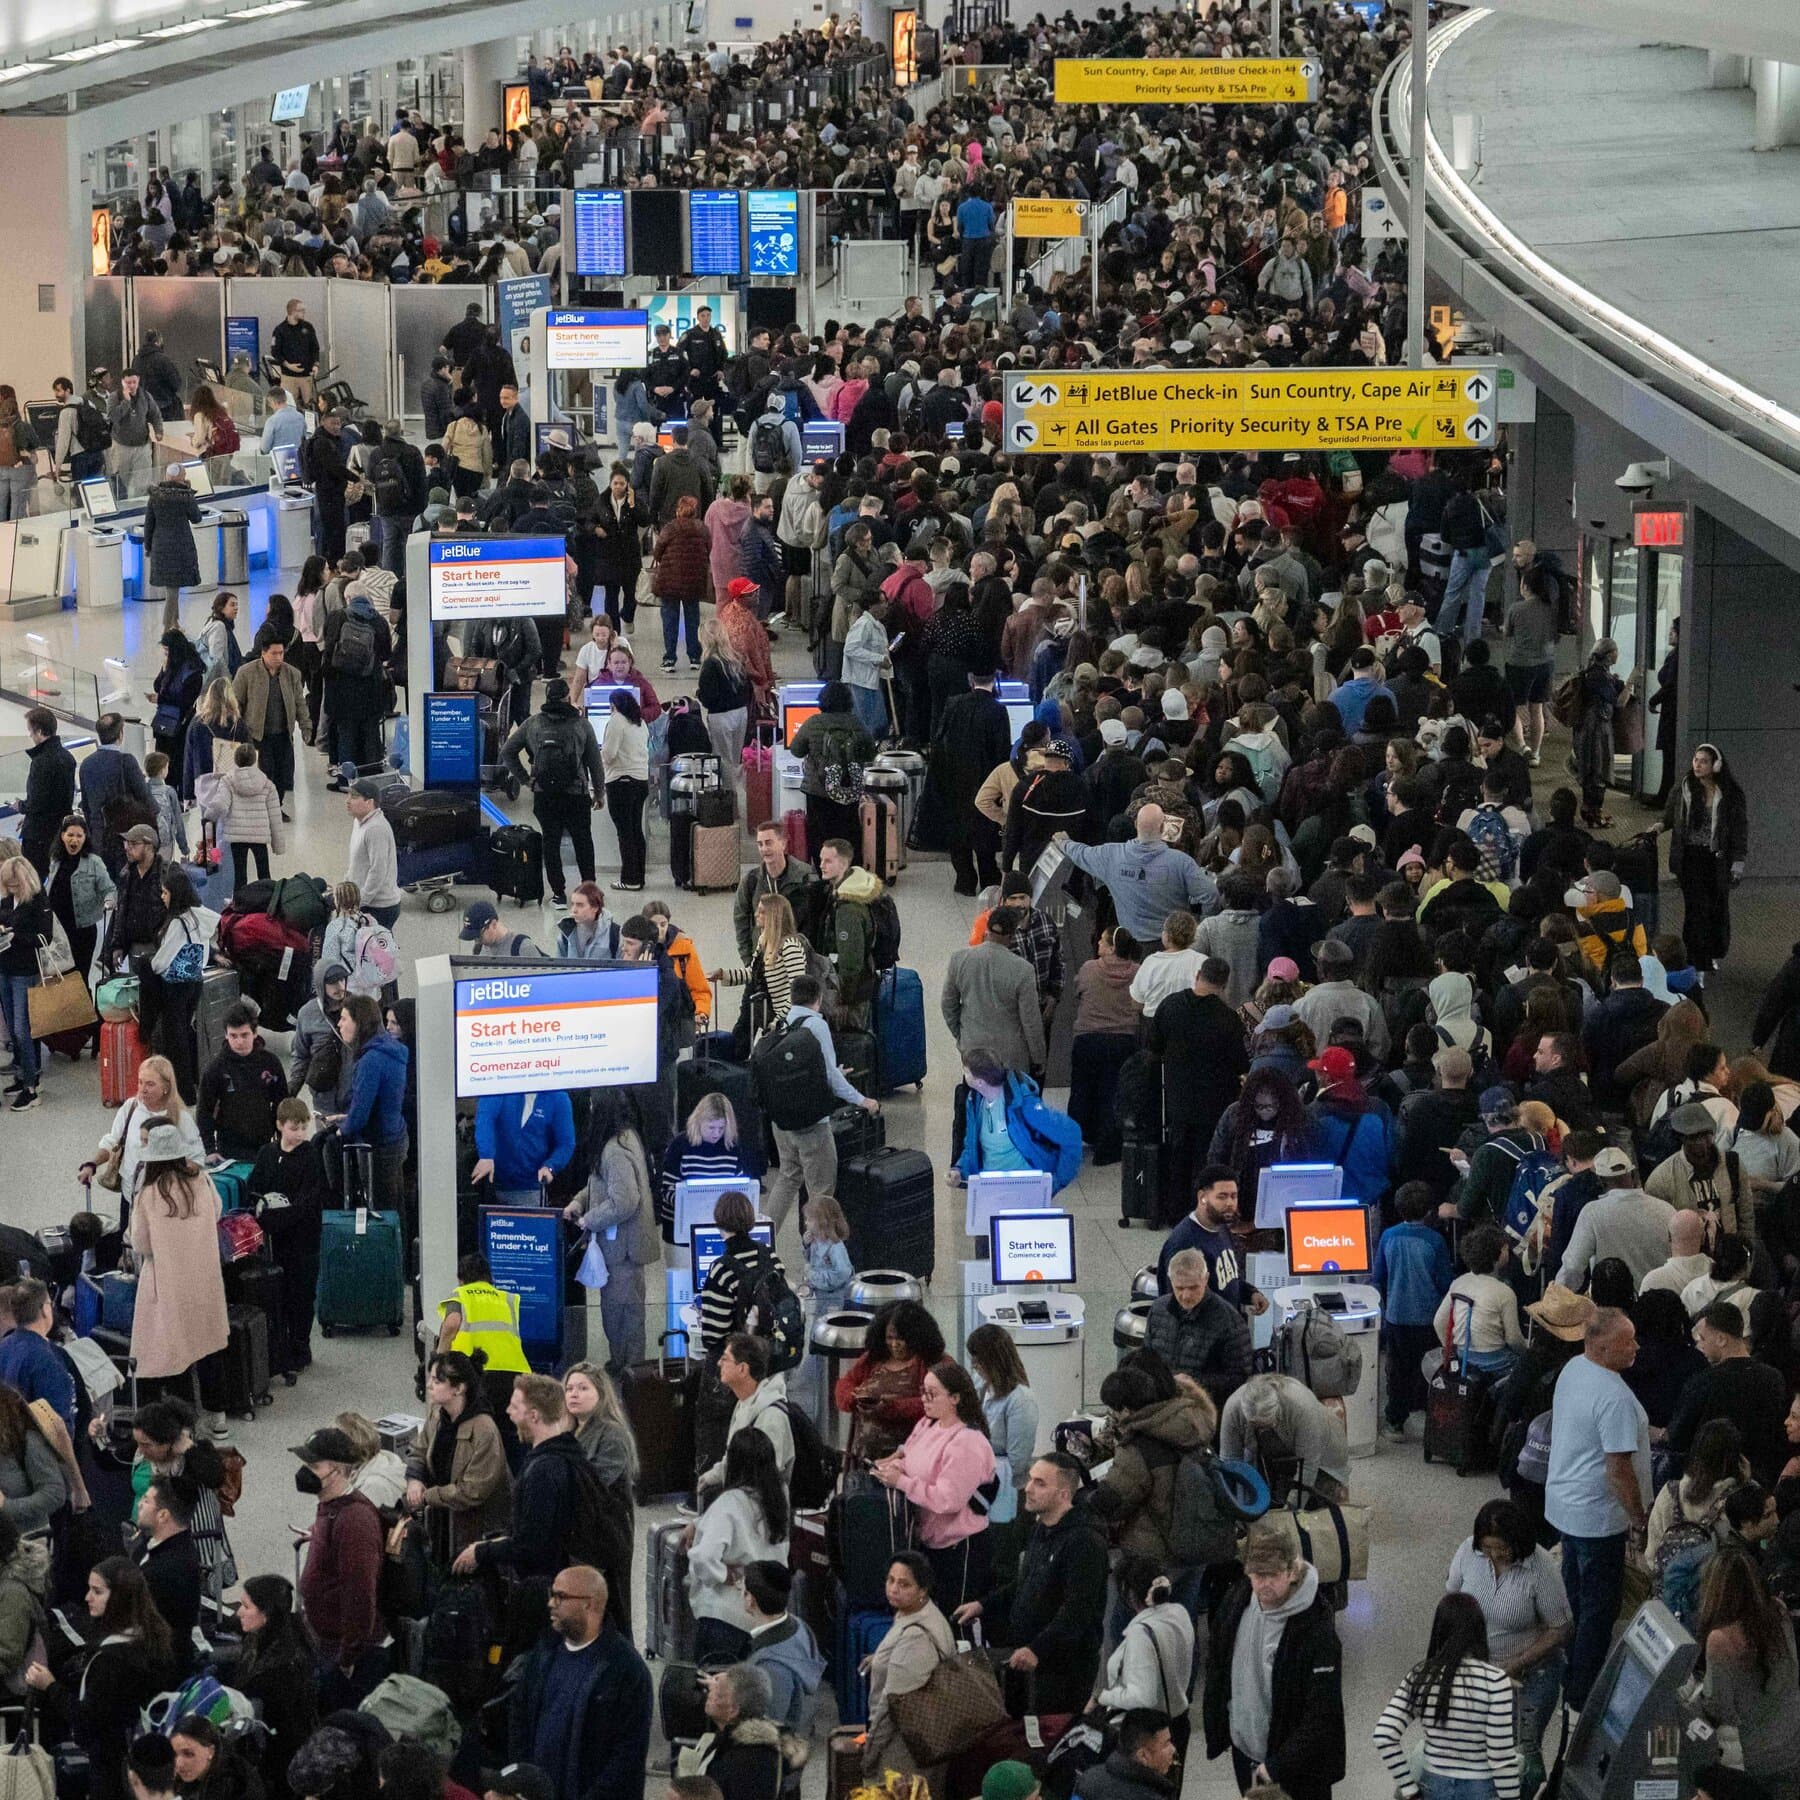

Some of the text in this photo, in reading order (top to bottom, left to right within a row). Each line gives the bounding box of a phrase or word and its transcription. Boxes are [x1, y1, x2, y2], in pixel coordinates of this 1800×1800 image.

[1084, 65, 1281, 77] Sun Country, Cape Air, JetBlue Check-in
[1136, 84, 1267, 95] Priority Security & TSA Pre
[507, 282, 534, 291] Everything
[555, 314, 585, 325] jetBlue
[556, 332, 600, 340] Start here
[1094, 384, 1238, 402] JetBlue Check-in
[1250, 381, 1431, 402] Sun Country, Cape Air
[1075, 420, 1158, 434] All Gates
[1170, 417, 1402, 436] Priority Security & TSA Pre
[1114, 439, 1144, 447] puertas
[1318, 435, 1359, 444] Seguridad
[1641, 513, 1681, 544] EXIT
[441, 545, 481, 560] jetBlue
[442, 570, 501, 581] Start here
[469, 981, 531, 1005] jetBlue
[471, 1019, 561, 1038] Start here
[470, 1040, 503, 1048] Check-in
[470, 1062, 531, 1073] Comenzar
[491, 1232, 537, 1242] Remember,
[1303, 1235, 1355, 1247] Check in.
[535, 1244, 548, 1253] up!
[1009, 1241, 1056, 1250] Start here.
